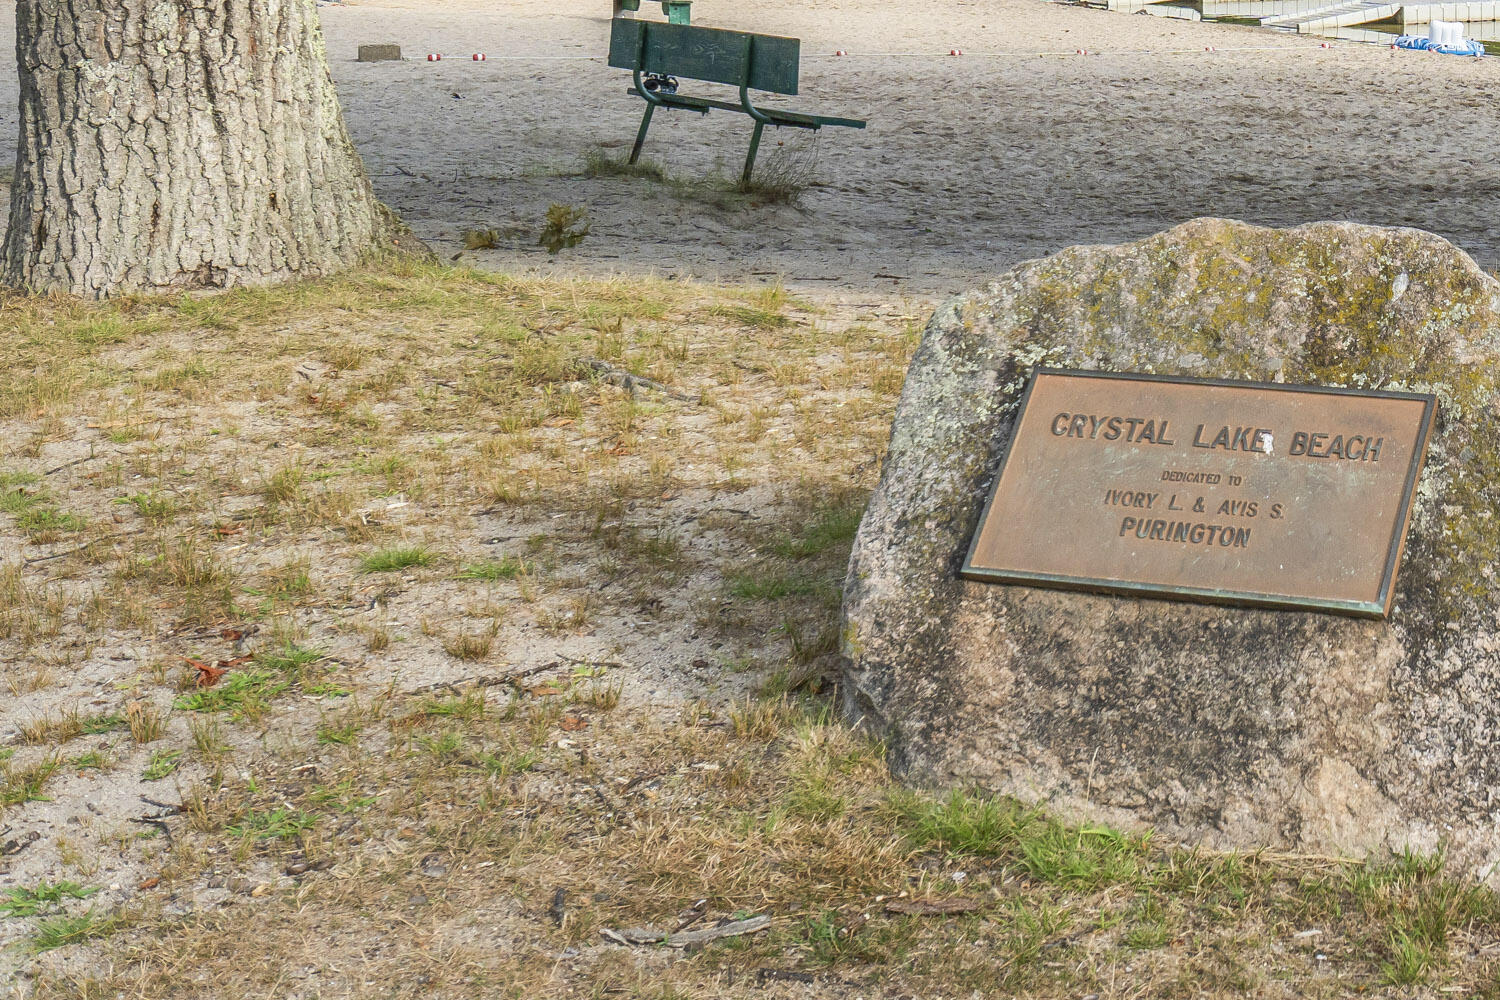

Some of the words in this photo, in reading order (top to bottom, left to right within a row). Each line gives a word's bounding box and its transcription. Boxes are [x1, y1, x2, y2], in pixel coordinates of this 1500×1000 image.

[1050, 411, 1175, 447] CRYSTAL
[1192, 424, 1273, 455] LAKE
[1290, 430, 1384, 463] BEACH
[1161, 470, 1222, 485] DEDICATED
[1228, 474, 1242, 487] TO
[1104, 489, 1159, 510] IVORY
[1193, 496, 1206, 514] &
[1217, 498, 1259, 519] AVIS
[1270, 502, 1285, 520] S.
[1119, 516, 1252, 549] PURINGTON
